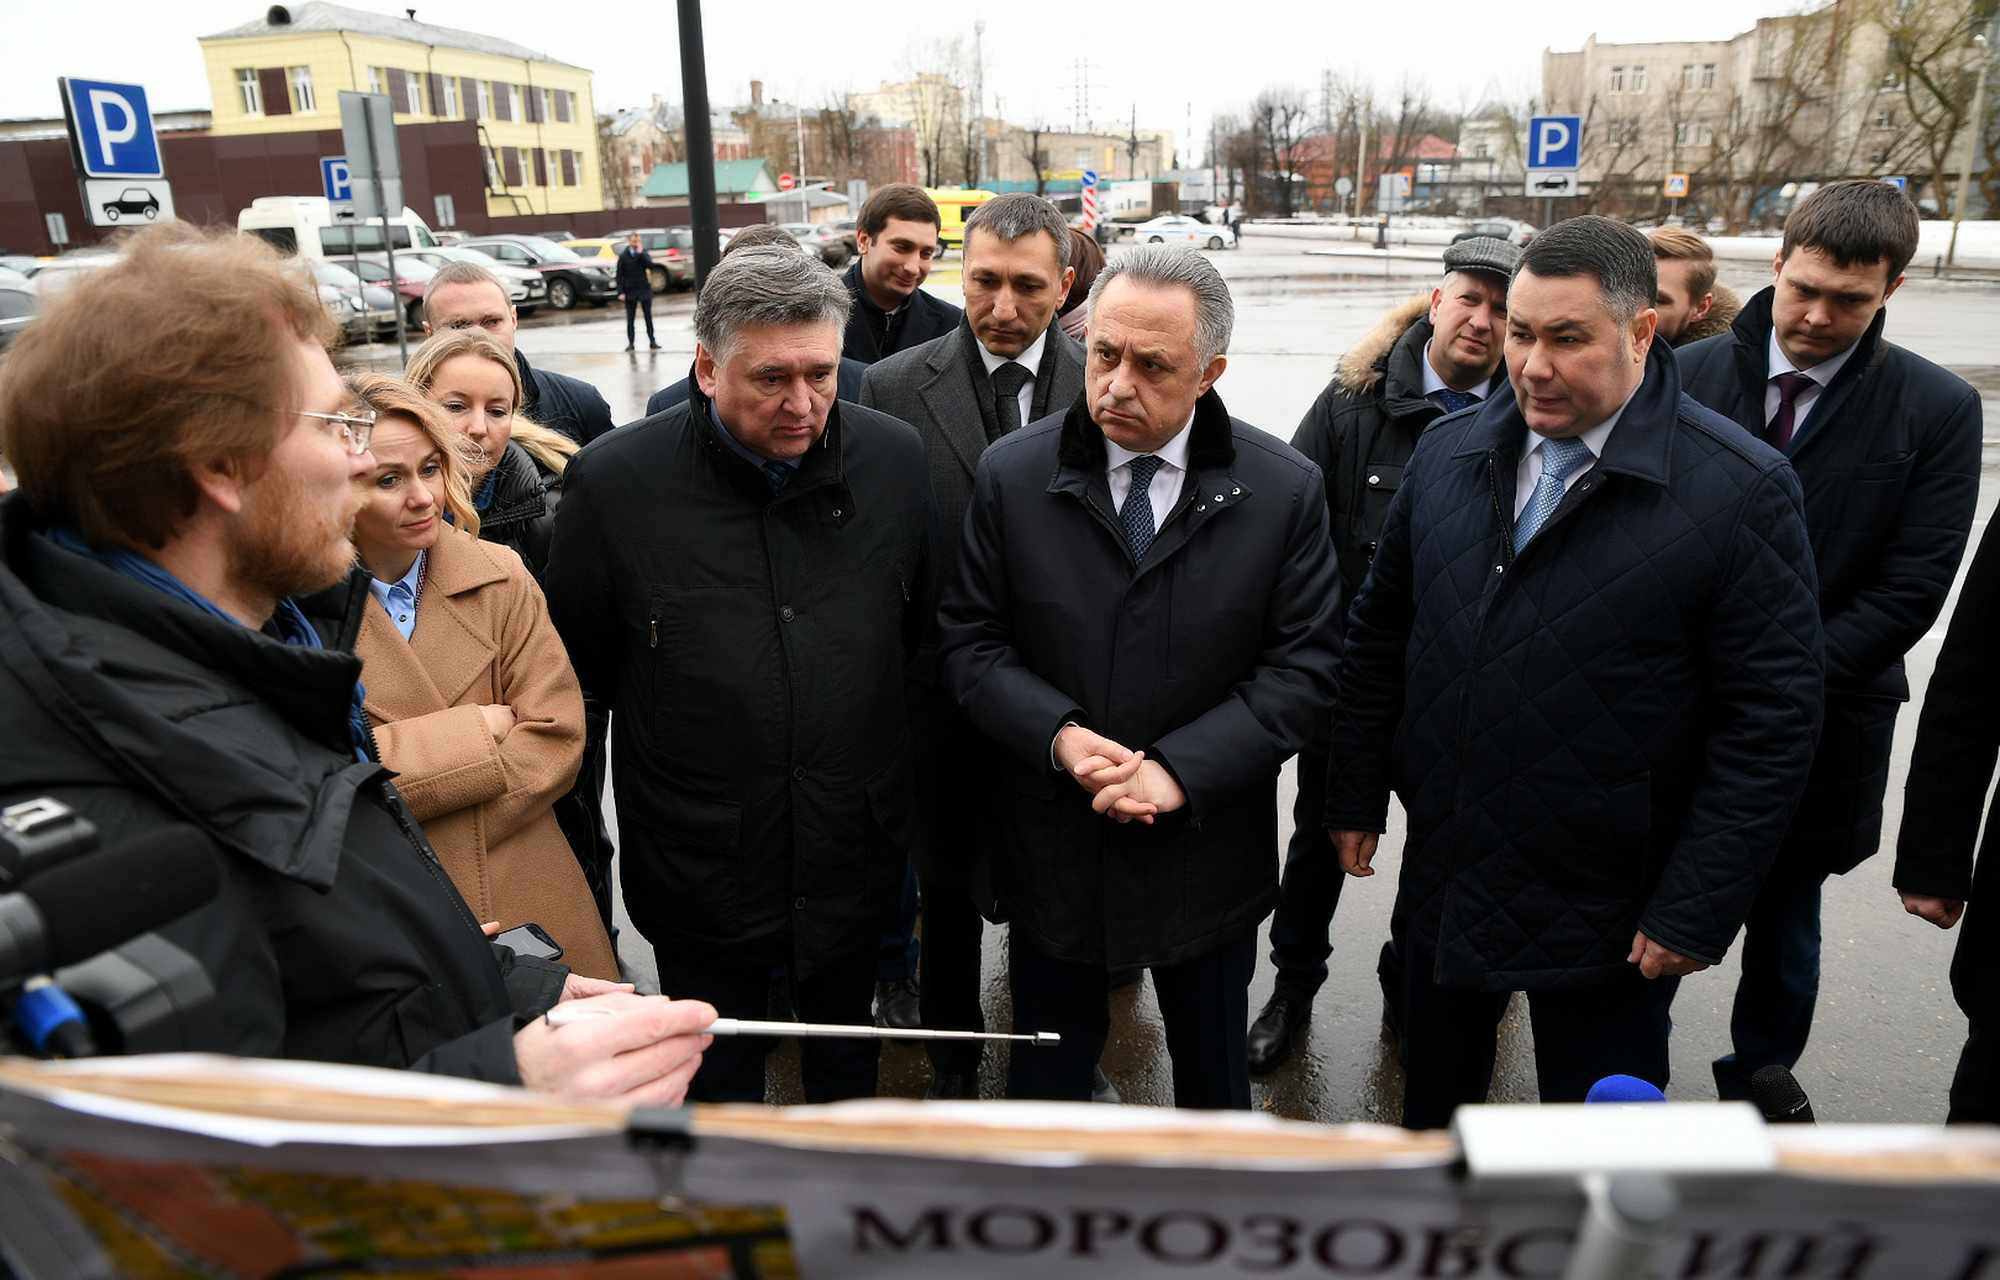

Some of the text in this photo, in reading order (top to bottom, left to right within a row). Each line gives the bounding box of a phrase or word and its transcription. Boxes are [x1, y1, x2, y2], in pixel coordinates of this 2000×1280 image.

[89, 89, 137, 166] P
[1538, 122, 1570, 165] P
[330, 163, 352, 198] P
[850, 1203, 1882, 1280] МОРОЗОВСИЙ
